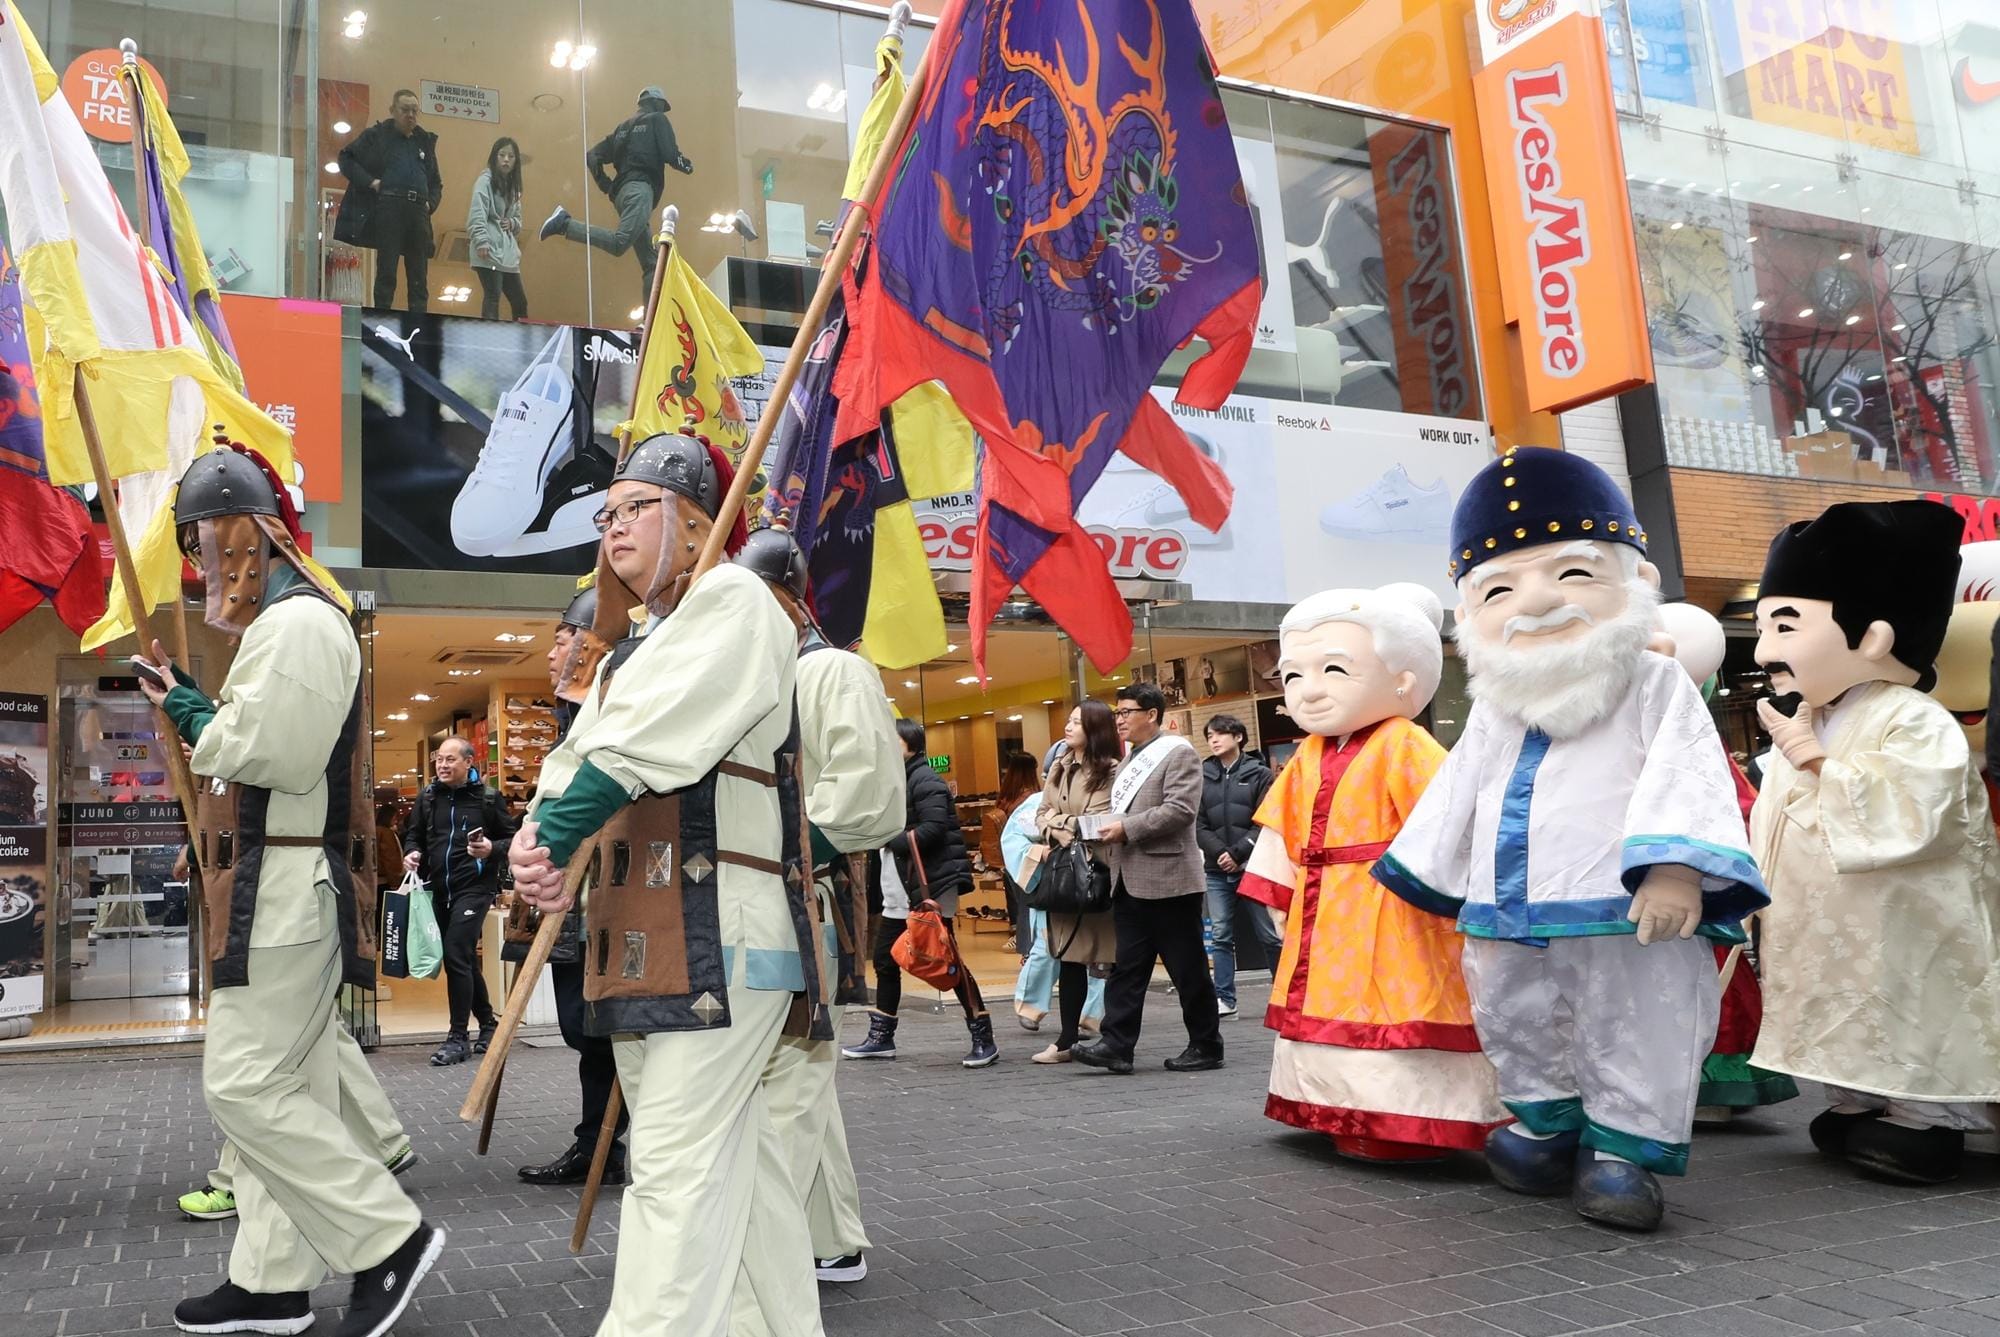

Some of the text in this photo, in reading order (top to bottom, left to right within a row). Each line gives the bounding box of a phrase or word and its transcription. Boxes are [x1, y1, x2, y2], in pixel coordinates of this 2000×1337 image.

[87, 61, 120, 77] GLO
[83, 75, 127, 104] TA
[1753, 43, 1898, 131] MART
[429, 93, 492, 108] TAX REFUND DESK
[83, 101, 131, 126] FRE
[1512, 70, 1584, 371] LesMore
[1277, 415, 1317, 430] Reebok
[1419, 428, 1451, 443] WORK
[918, 522, 1182, 571] esore
[17, 702, 39, 713] cake
[80, 807, 113, 818] JUNO
[149, 807, 179, 817] HAIR
[0, 834, 16, 845] ium
[0, 846, 29, 857] colate
[385, 911, 394, 960] BORN FROM
[391, 945, 399, 960] THE
